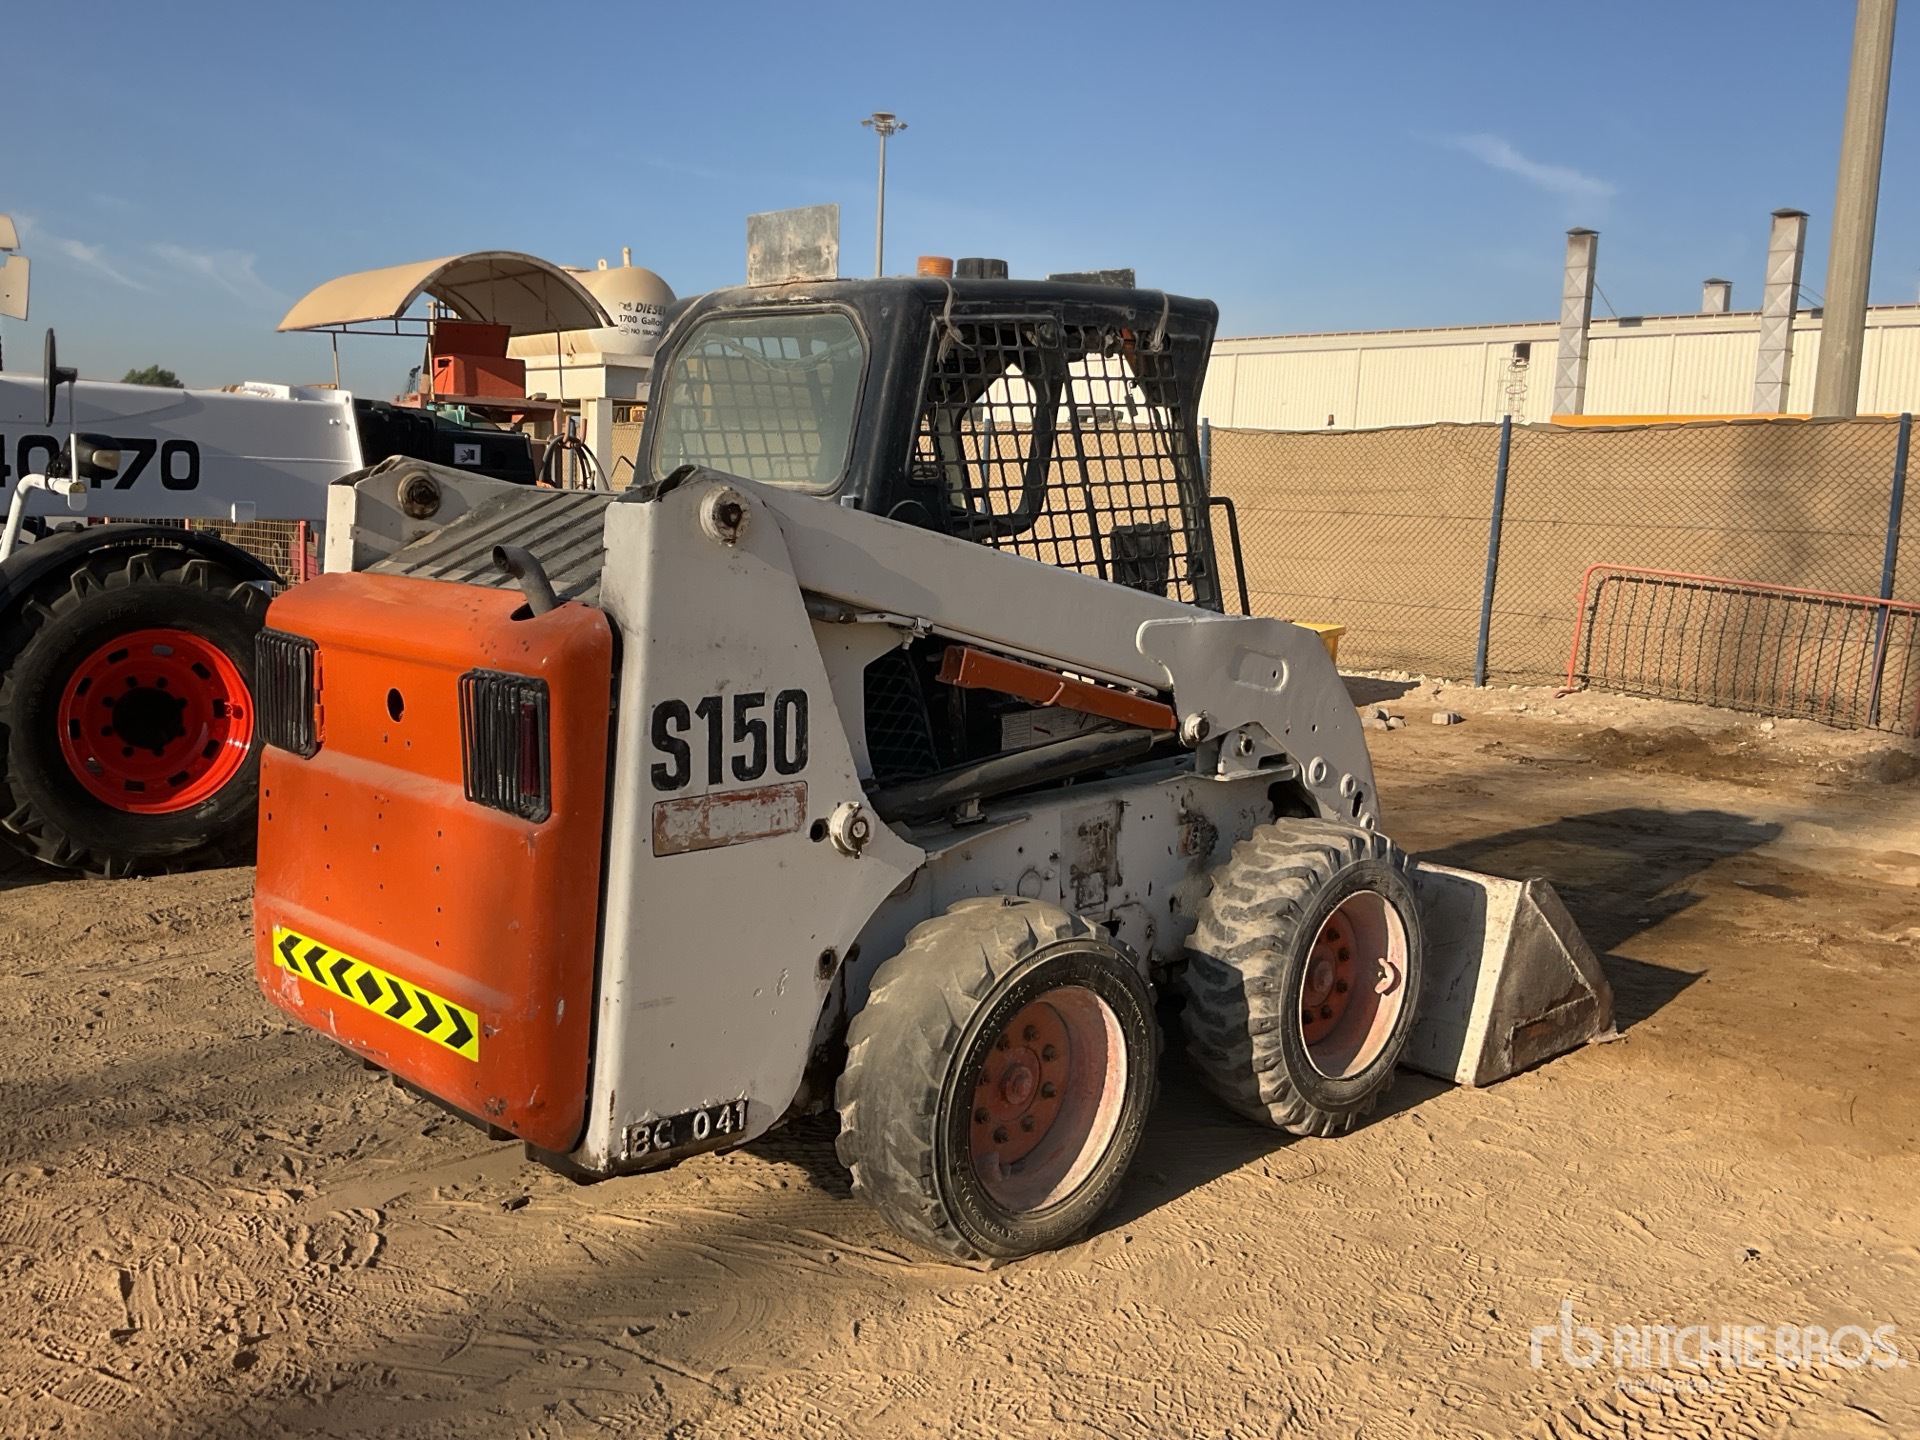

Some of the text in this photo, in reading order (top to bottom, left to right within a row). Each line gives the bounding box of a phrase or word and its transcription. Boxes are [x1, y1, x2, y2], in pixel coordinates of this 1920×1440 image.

[618, 315, 637, 324] 1700
[650, 689, 809, 791] S150
[693, 1100, 746, 1141] 041
